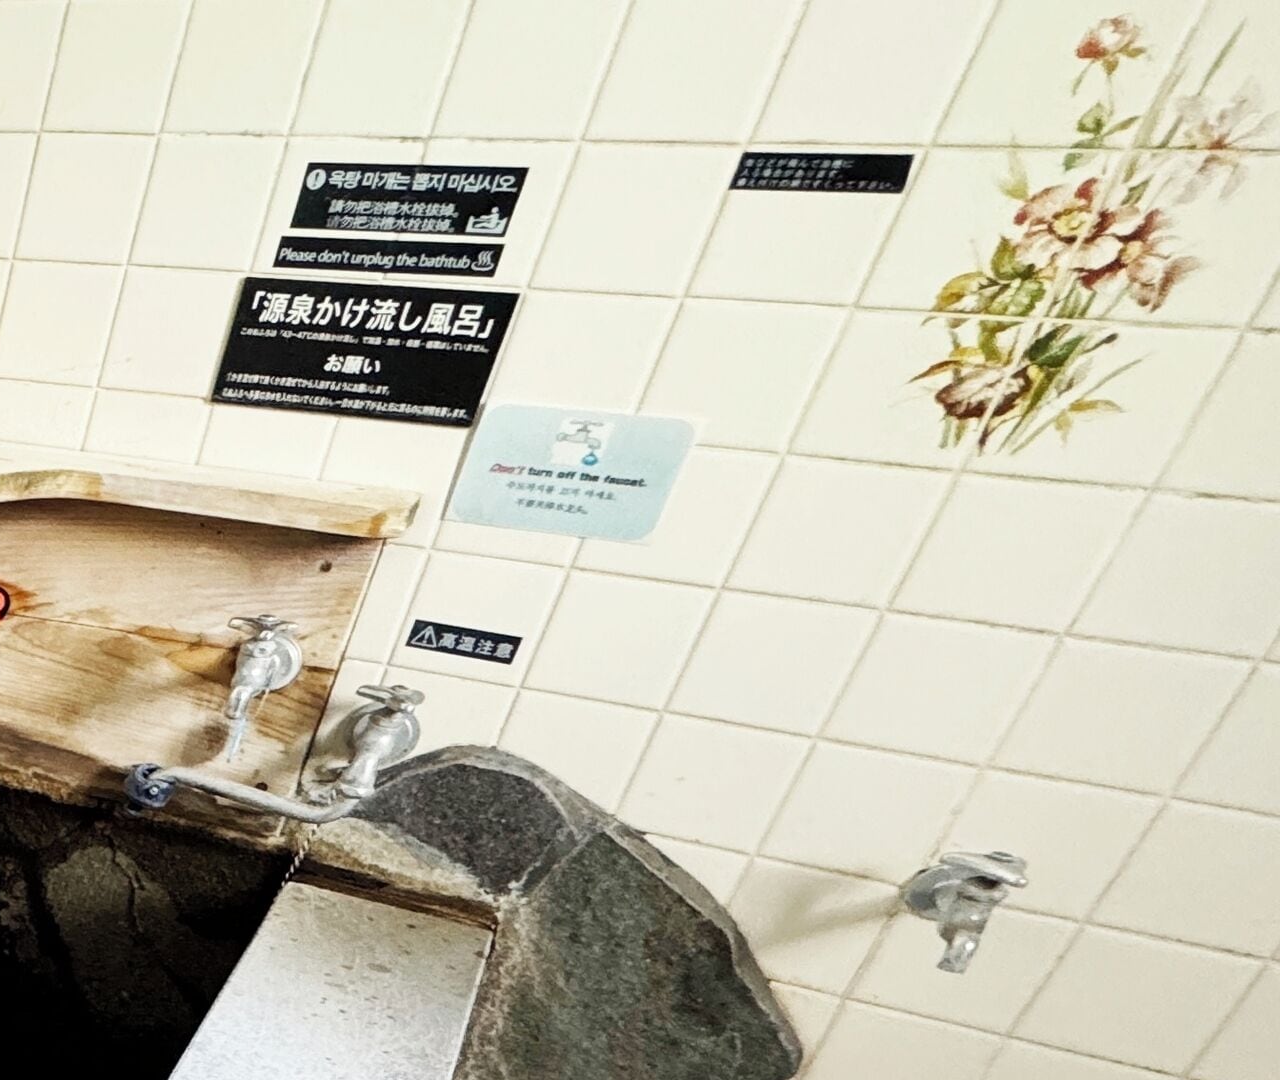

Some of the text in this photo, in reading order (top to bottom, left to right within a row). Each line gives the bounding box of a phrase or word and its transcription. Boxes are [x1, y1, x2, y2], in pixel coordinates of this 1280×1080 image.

[328, 169, 361, 189] 욕탕
[362, 171, 411, 190] 마개는
[412, 172, 444, 192] 뽑지
[278, 246, 472, 270] Please don't unplug the bathtub
[250, 290, 496, 339] 「源泉かけ流し風呂」
[323, 354, 382, 375] お願い
[489, 462, 527, 476] Don't
[527, 466, 553, 478] turn
[557, 470, 578, 480] off
[579, 472, 600, 482] the
[437, 631, 515, 659] 高温注意
